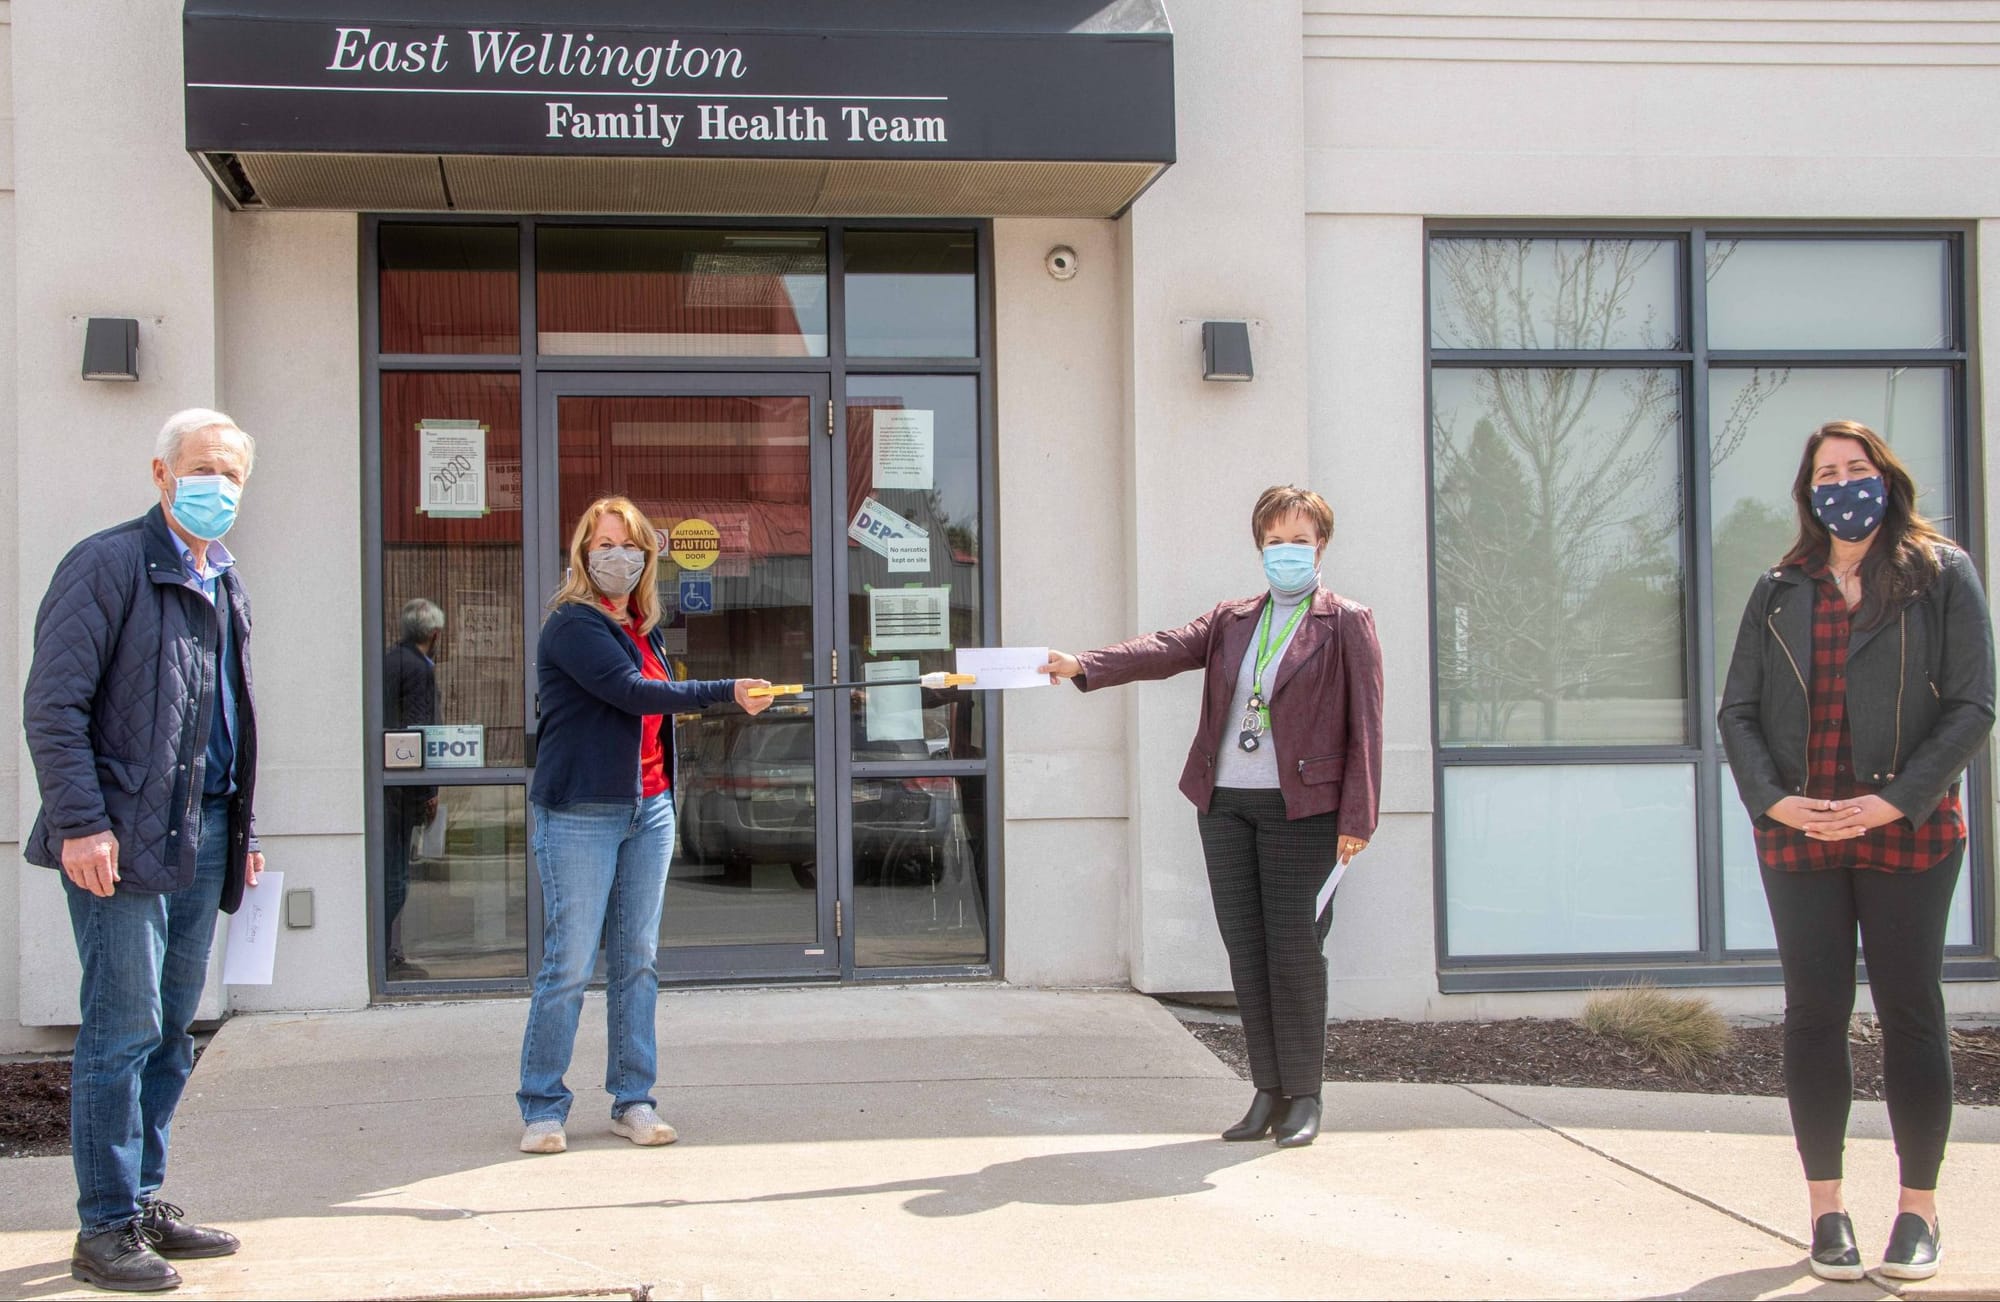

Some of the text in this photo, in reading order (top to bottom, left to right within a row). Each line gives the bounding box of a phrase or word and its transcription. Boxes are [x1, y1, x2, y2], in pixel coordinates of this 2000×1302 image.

[326, 28, 748, 87] East Wellington
[545, 102, 948, 148] Family Health Team
[433, 455, 471, 492] 2020
[673, 540, 718, 550] CAUTION
[891, 556, 906, 564] kept
[427, 741, 479, 757] EPOT
